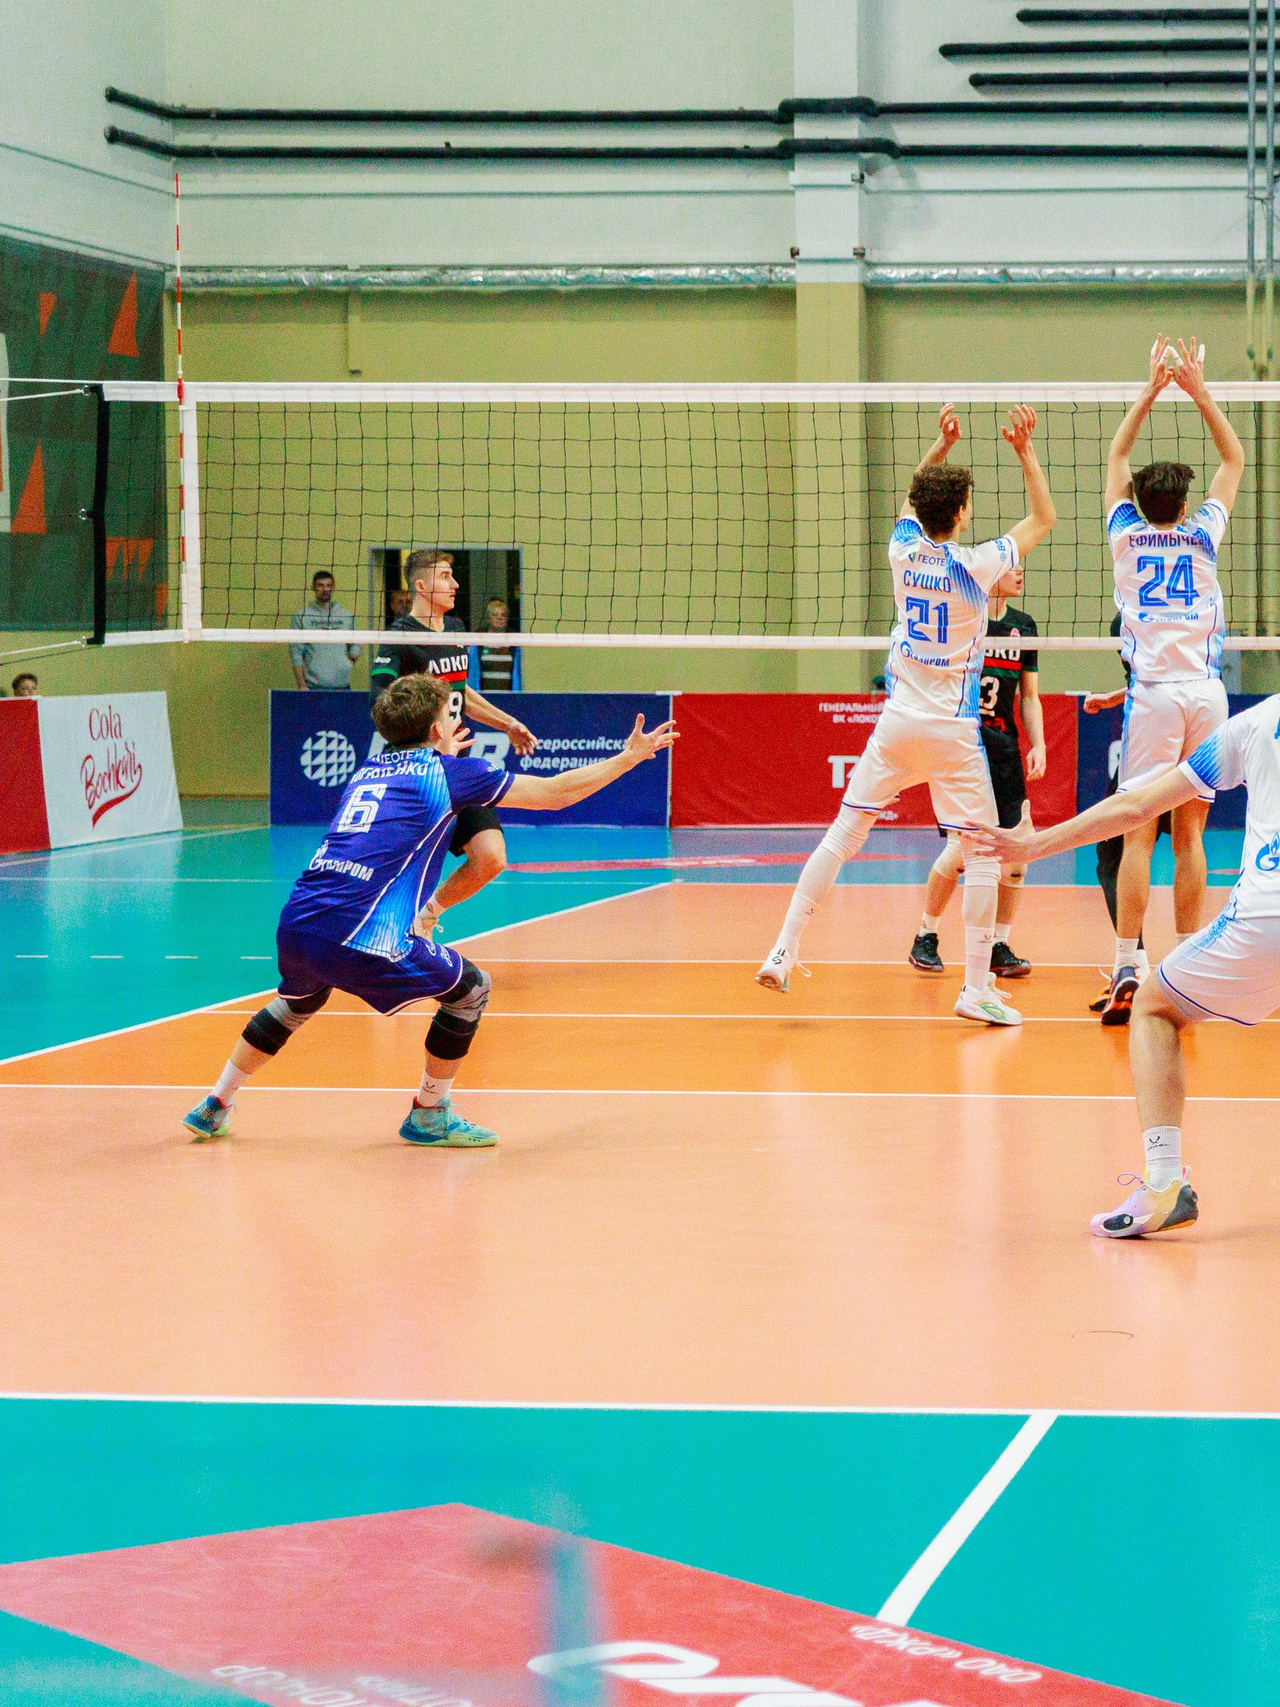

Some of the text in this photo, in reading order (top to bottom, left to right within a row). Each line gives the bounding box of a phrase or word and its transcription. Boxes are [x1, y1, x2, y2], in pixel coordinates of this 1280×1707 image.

[917, 553, 947, 567] ГЕОТЕ
[903, 569, 952, 593] СУШКО
[1137, 554, 1200, 607] 24
[905, 596, 949, 645] 21
[428, 653, 469, 675] ЛОКО
[88, 704, 122, 741] Cola
[532, 736, 628, 753] сероссийска
[519, 755, 608, 771] федераци
[336, 783, 388, 833] 6
[954, 1657, 1043, 1684] ОАО
